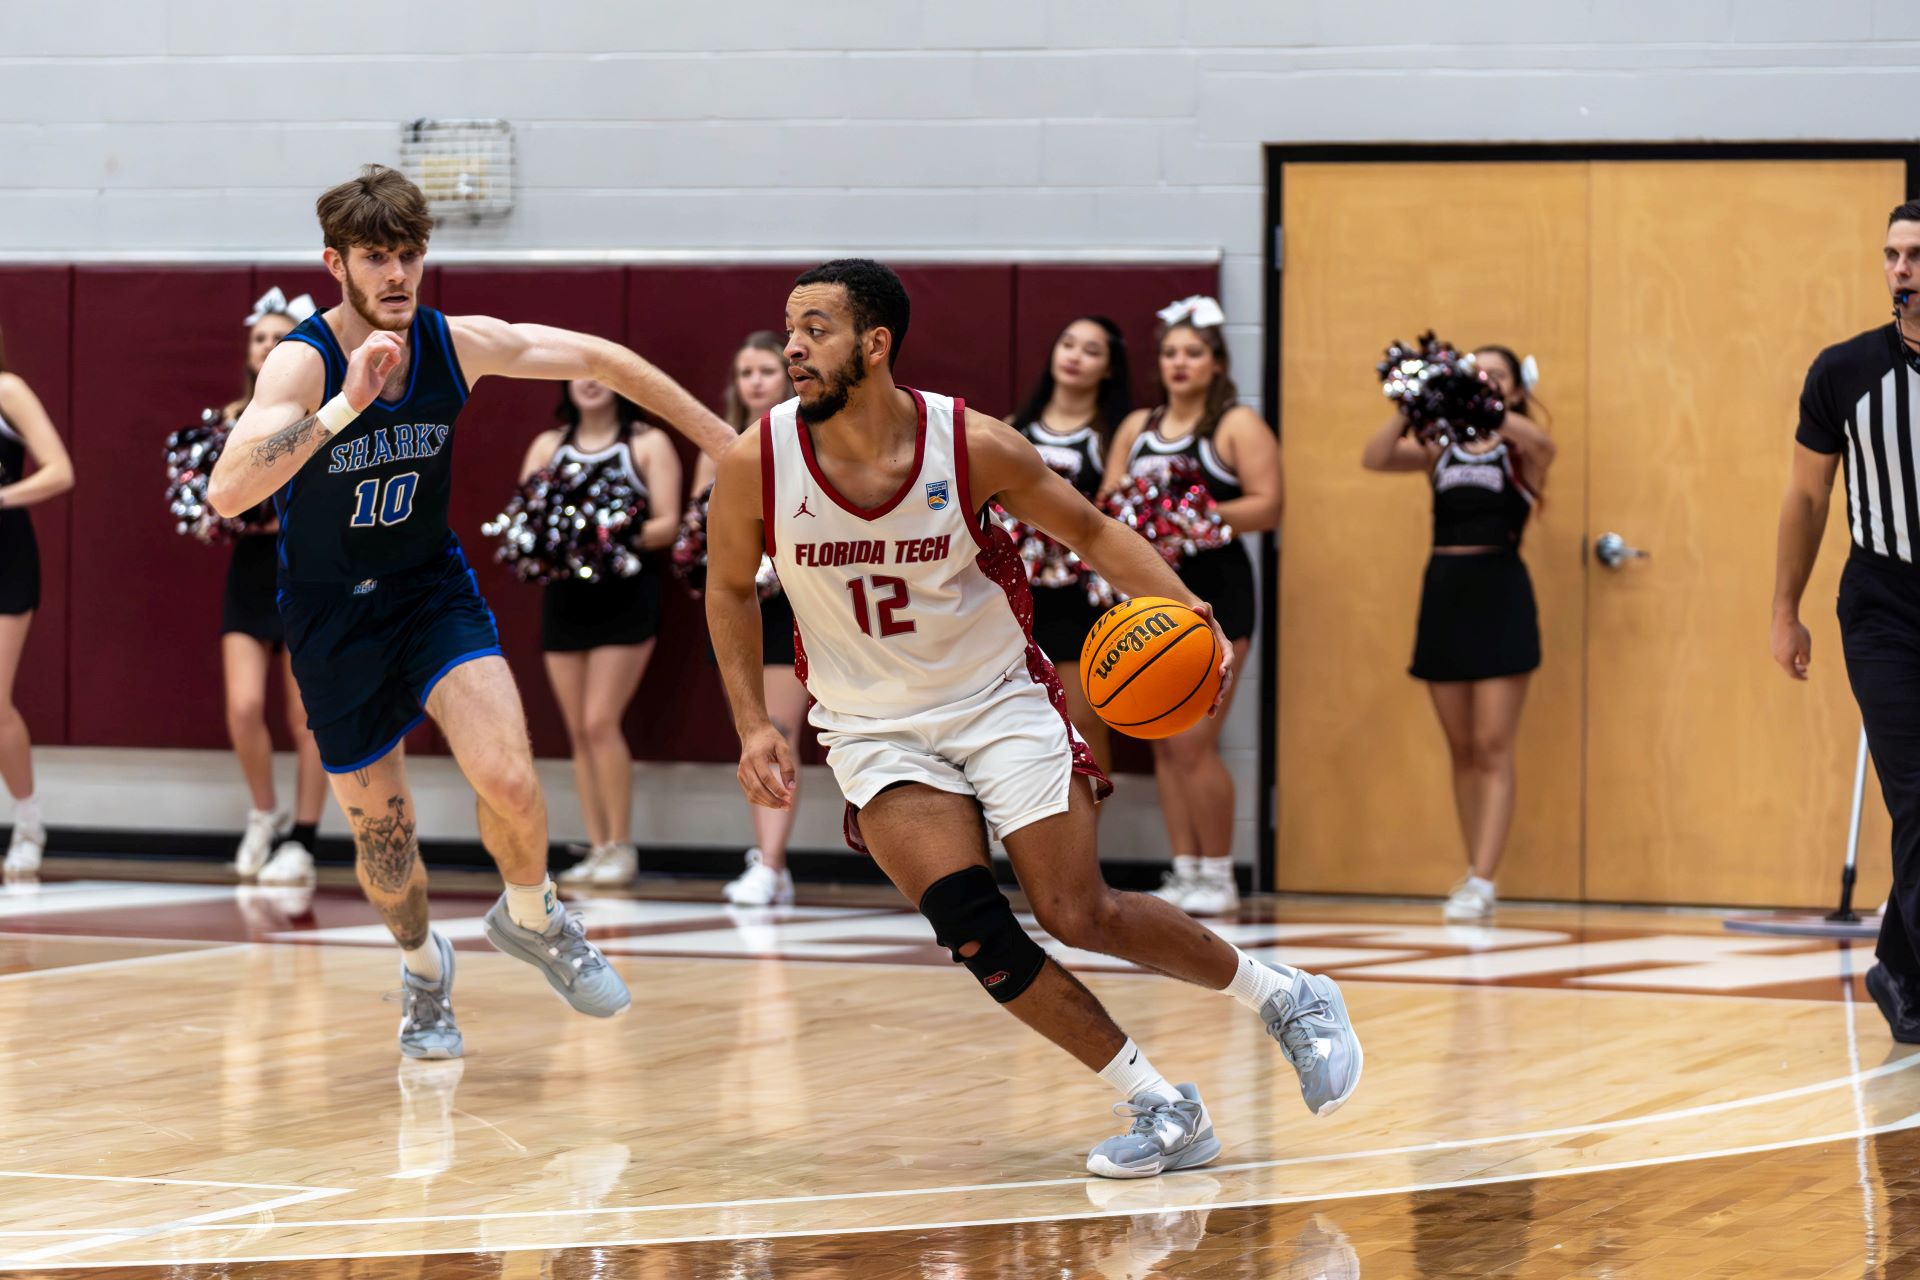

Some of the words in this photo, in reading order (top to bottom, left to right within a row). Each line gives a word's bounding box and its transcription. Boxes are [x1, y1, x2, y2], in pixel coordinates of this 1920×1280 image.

[328, 424, 449, 473] SHARKS
[350, 471, 420, 528] 10
[794, 540, 885, 567] FLORIDA
[894, 534, 951, 564] TECH
[846, 573, 917, 639] 12
[1095, 611, 1181, 680] Wilson
